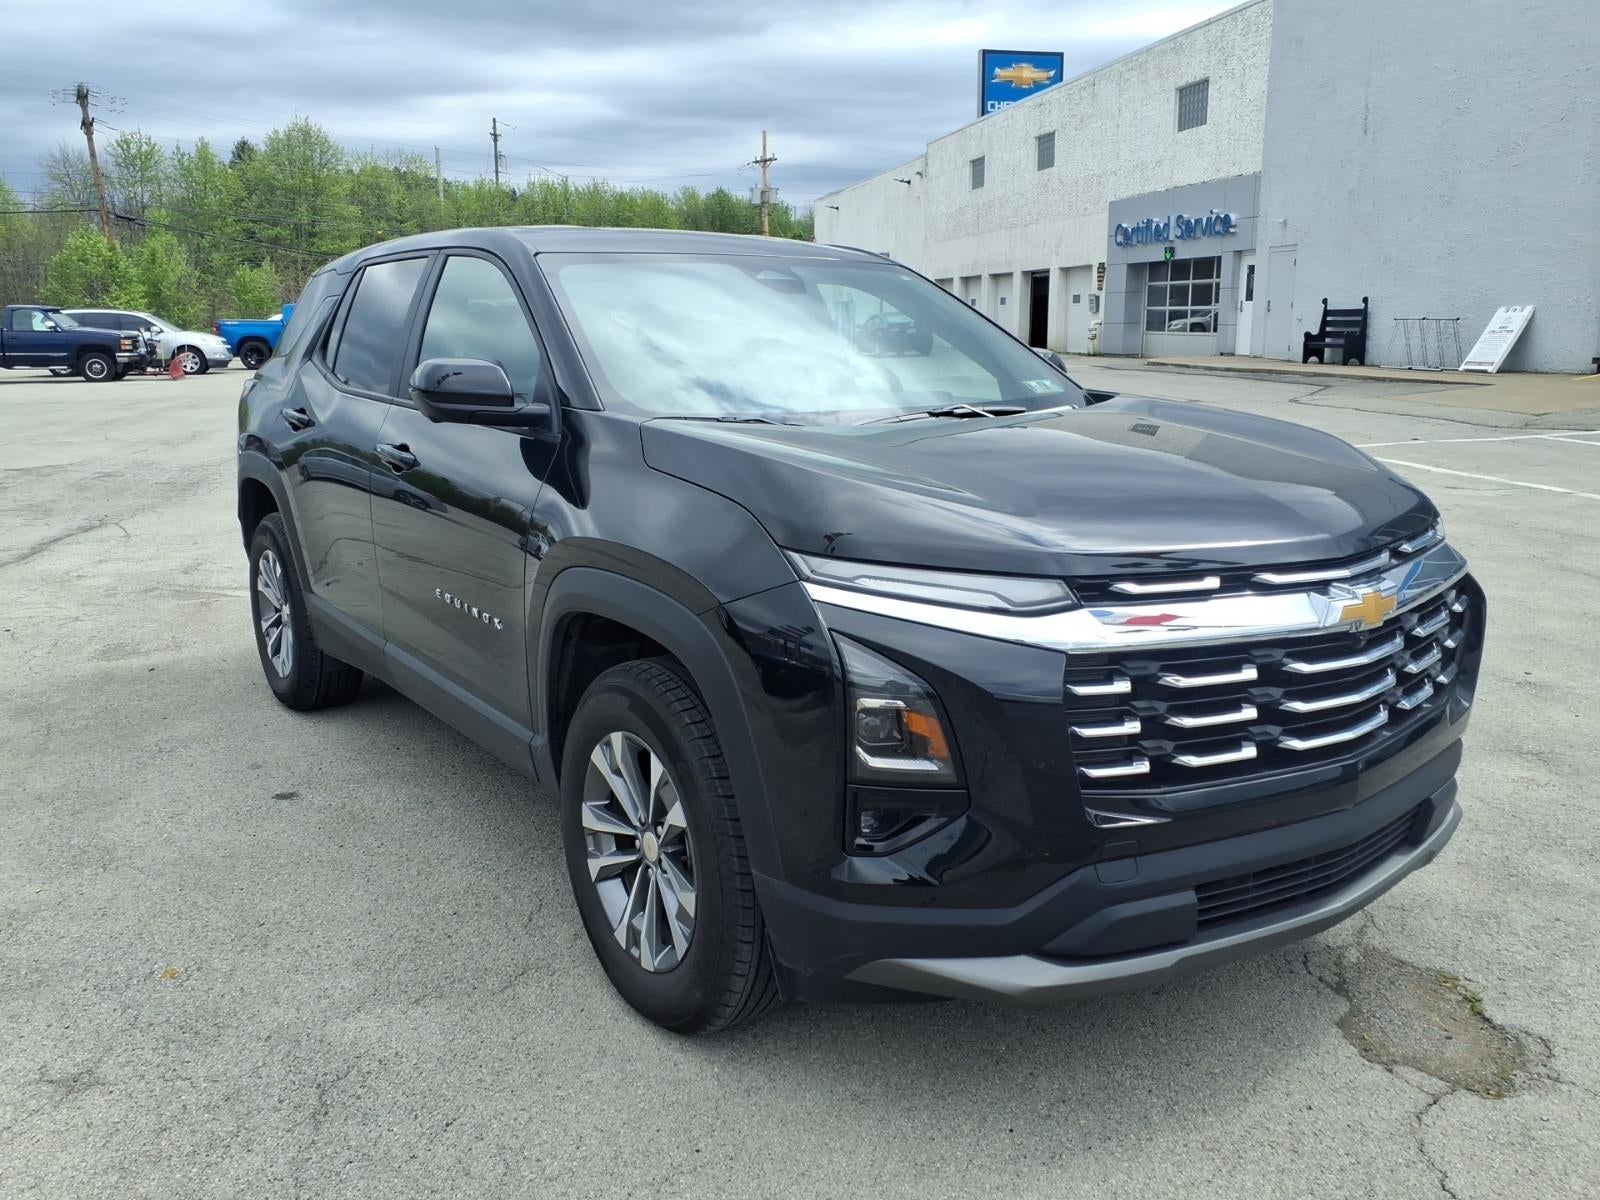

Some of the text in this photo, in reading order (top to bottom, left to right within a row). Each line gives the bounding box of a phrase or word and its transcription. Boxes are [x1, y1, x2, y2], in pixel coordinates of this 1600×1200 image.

[1115, 209, 1236, 247] Certified Service
[435, 587, 503, 630] EQUINOX
